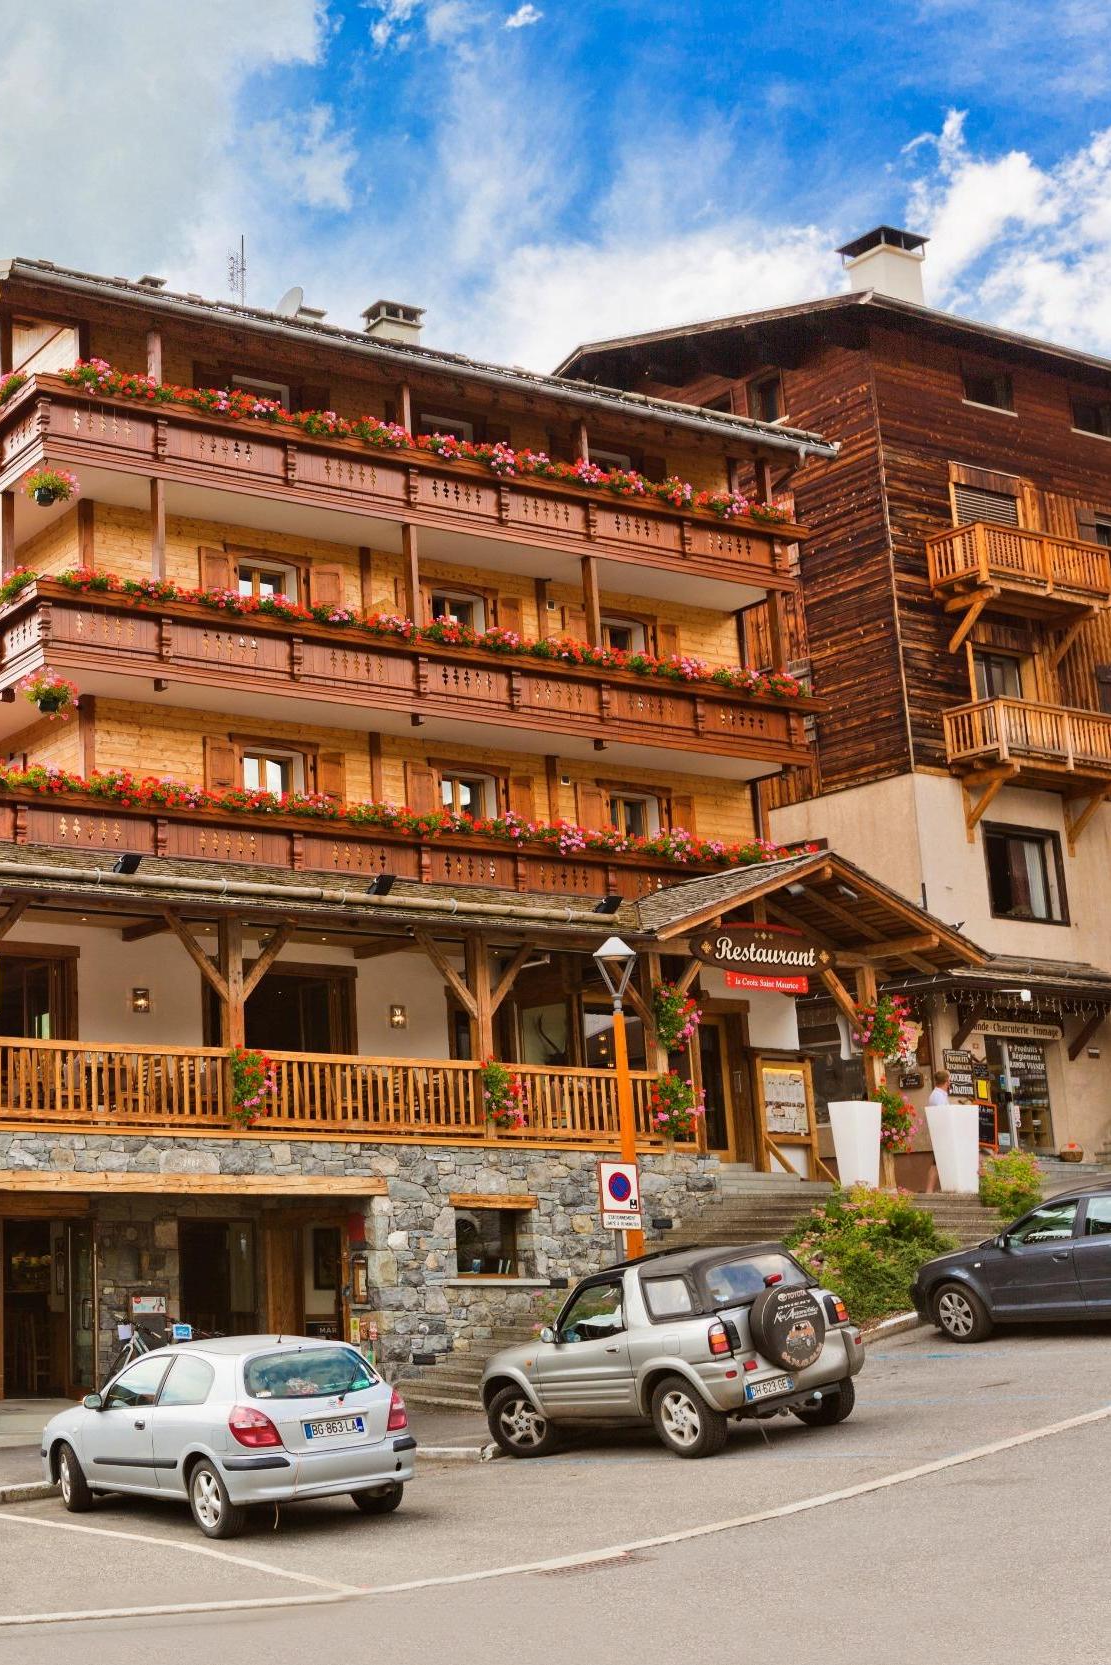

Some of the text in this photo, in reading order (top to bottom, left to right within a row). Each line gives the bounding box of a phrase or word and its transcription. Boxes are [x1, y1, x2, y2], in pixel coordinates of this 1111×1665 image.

[715, 936, 817, 967] Restaurant
[742, 978, 758, 986] Croix
[760, 978, 774, 987] Saint
[776, 980, 799, 989] Maurice
[993, 1022, 1029, 1034] Charcuterie
[1033, 1026, 1059, 1038] Fromage
[786, 1289, 807, 1300] TOYOTA
[777, 1299, 811, 1310] ORIENT
